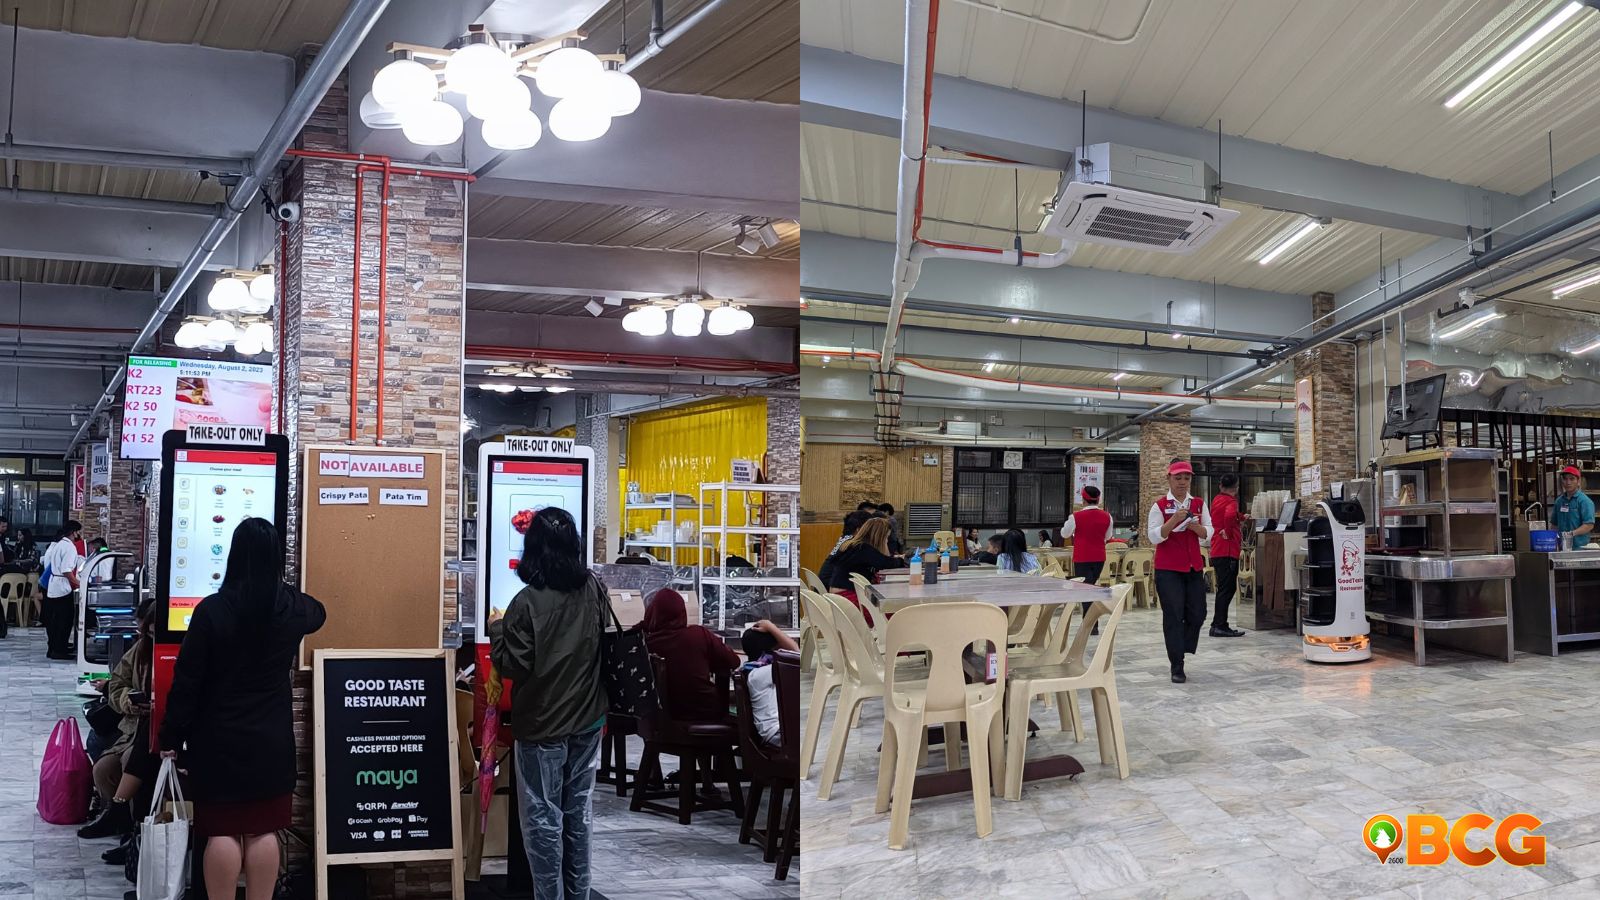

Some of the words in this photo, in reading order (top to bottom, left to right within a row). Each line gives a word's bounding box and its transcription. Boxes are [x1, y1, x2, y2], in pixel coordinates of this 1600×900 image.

[180, 361, 217, 370] Wednesday,
[218, 363, 241, 372] August
[128, 368, 143, 379] K2
[126, 385, 162, 396] RT223
[125, 401, 140, 411] K2
[143, 402, 158, 411] 50
[123, 417, 137, 427] K1
[142, 418, 156, 427] 77
[122, 433, 136, 443] K1
[140, 433, 155, 443] 52
[189, 426, 236, 440] TAKE-OUT
[239, 428, 264, 442] ONLY
[507, 439, 549, 452] TAKE-OUT
[551, 440, 573, 454] ONLY
[321, 460, 349, 470] NOT
[350, 462, 423, 473] AVAILABLE
[320, 492, 346, 500] Crispy
[348, 491, 368, 499] Pata
[345, 679, 386, 691] GOOD
[388, 679, 425, 691] TASTE
[344, 696, 427, 708] RESTAURANT
[350, 744, 398, 754] ACCEPTED
[400, 743, 423, 753] HERE
[356, 768, 418, 790] maya
[377, 816, 403, 825] GrabPay
[416, 815, 429, 824] Pay
[350, 831, 368, 840] VISA
